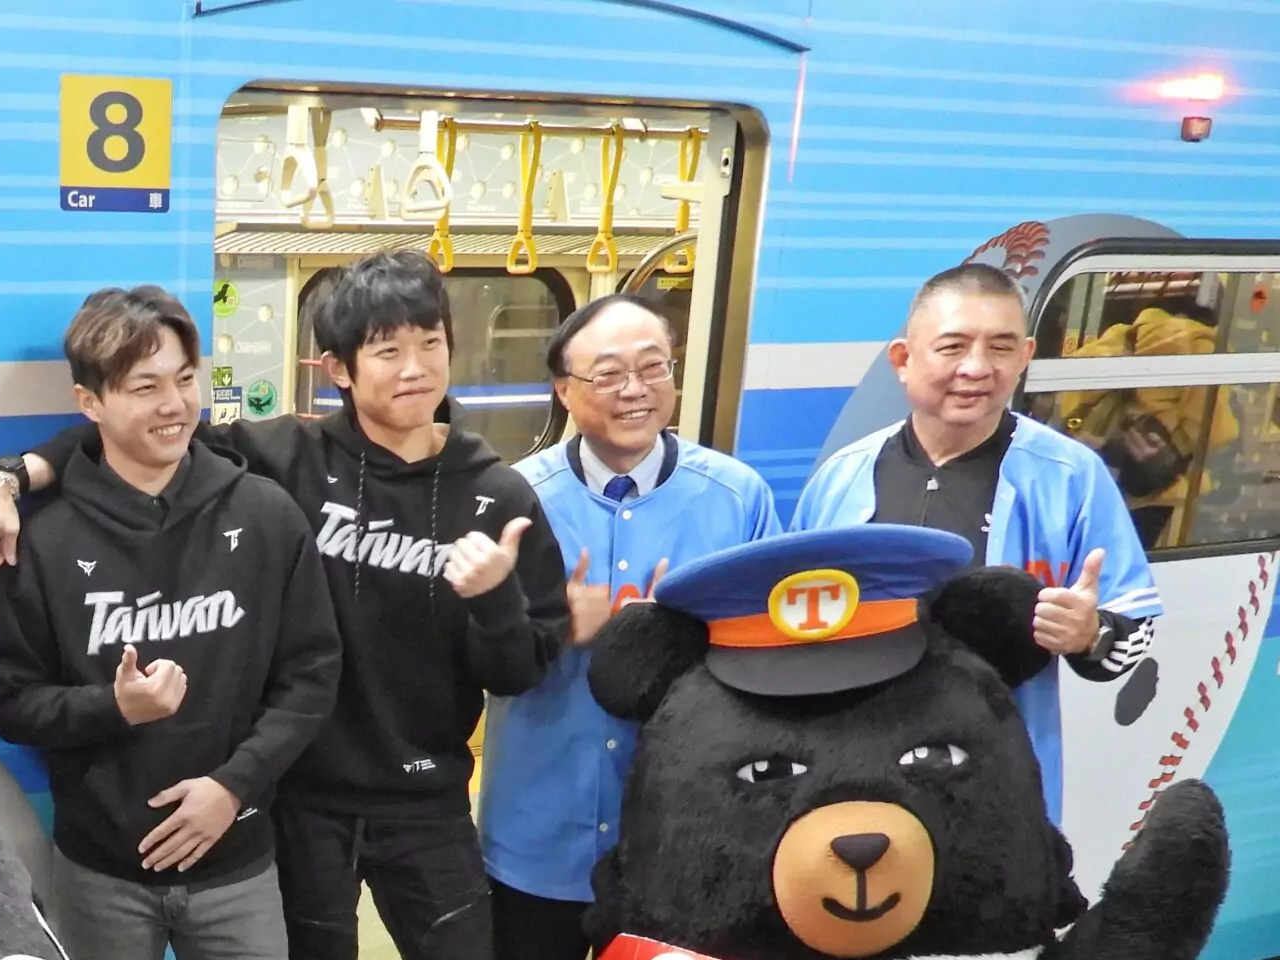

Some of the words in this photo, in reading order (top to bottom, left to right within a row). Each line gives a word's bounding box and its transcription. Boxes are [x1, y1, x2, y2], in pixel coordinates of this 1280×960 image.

[86, 90, 146, 174] 8
[67, 190, 95, 208] Car
[148, 192, 163, 209] 車
[84, 590, 246, 656] Taiwan
[786, 582, 841, 631] T
